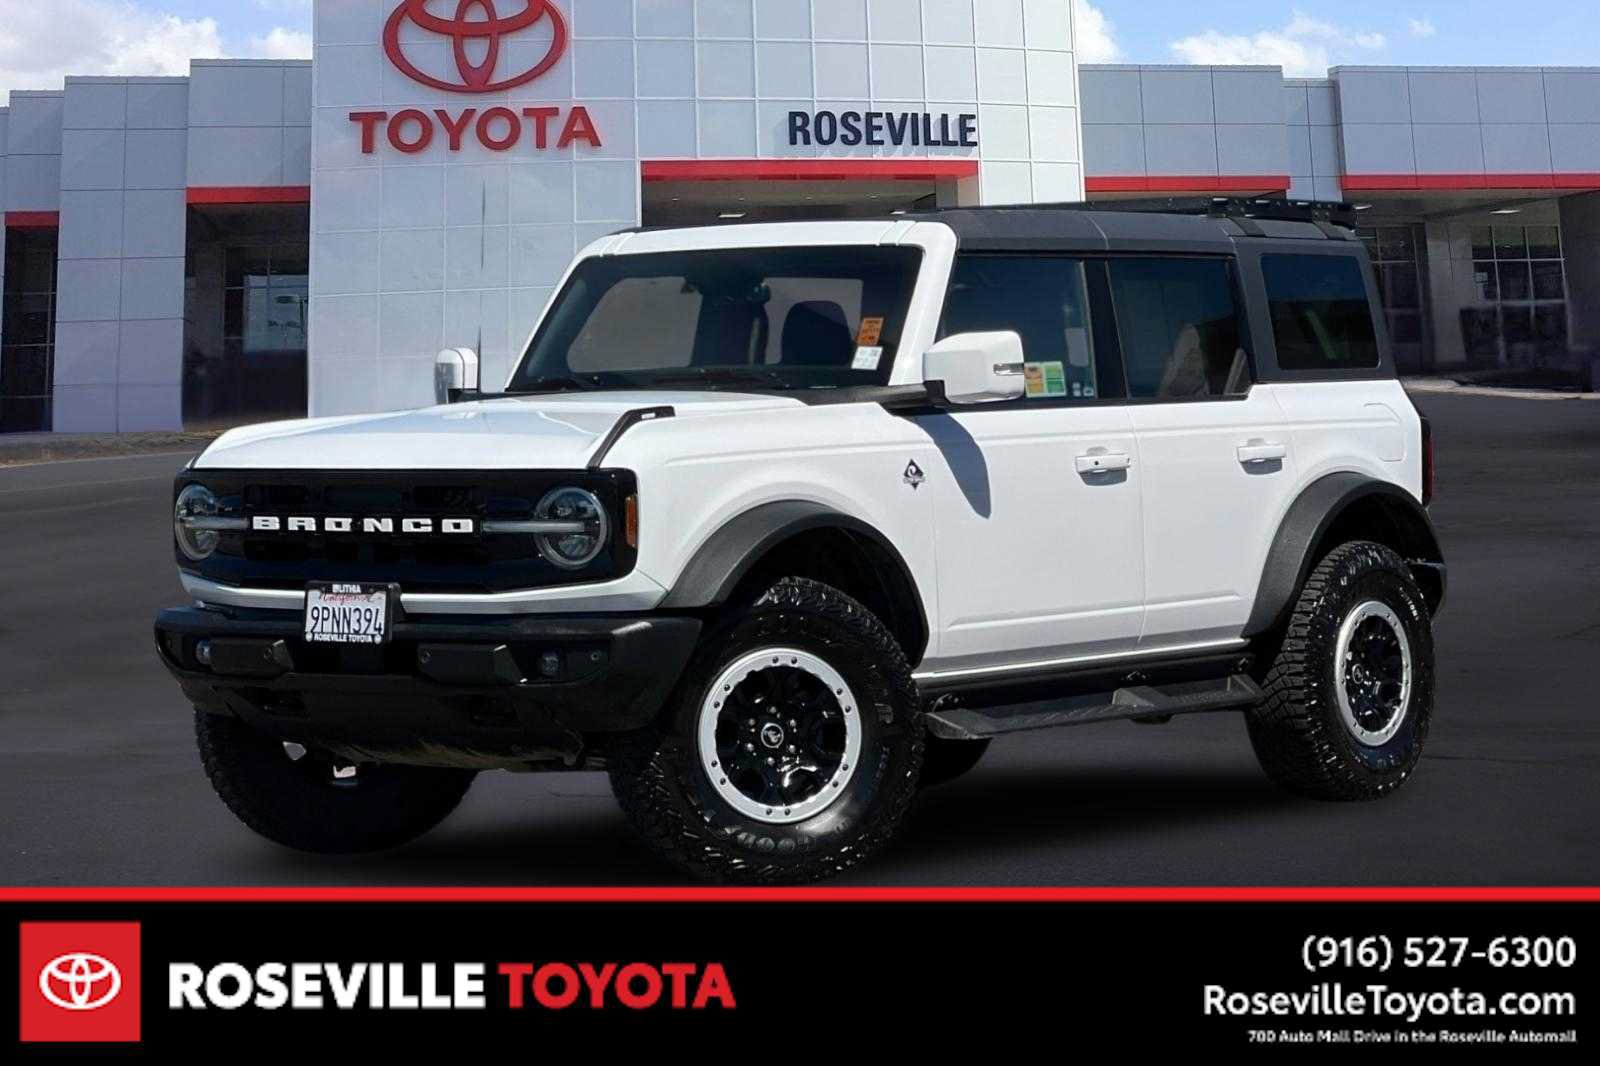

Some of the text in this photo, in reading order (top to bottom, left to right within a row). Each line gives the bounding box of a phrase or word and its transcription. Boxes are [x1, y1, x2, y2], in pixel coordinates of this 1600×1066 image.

[349, 105, 603, 153] TOYOTA
[788, 111, 978, 147] ROSEVILLE
[252, 516, 475, 533] BRONCO
[311, 606, 382, 635] 9PNN394
[314, 633, 373, 643] ROSEVILLE TOYOTA
